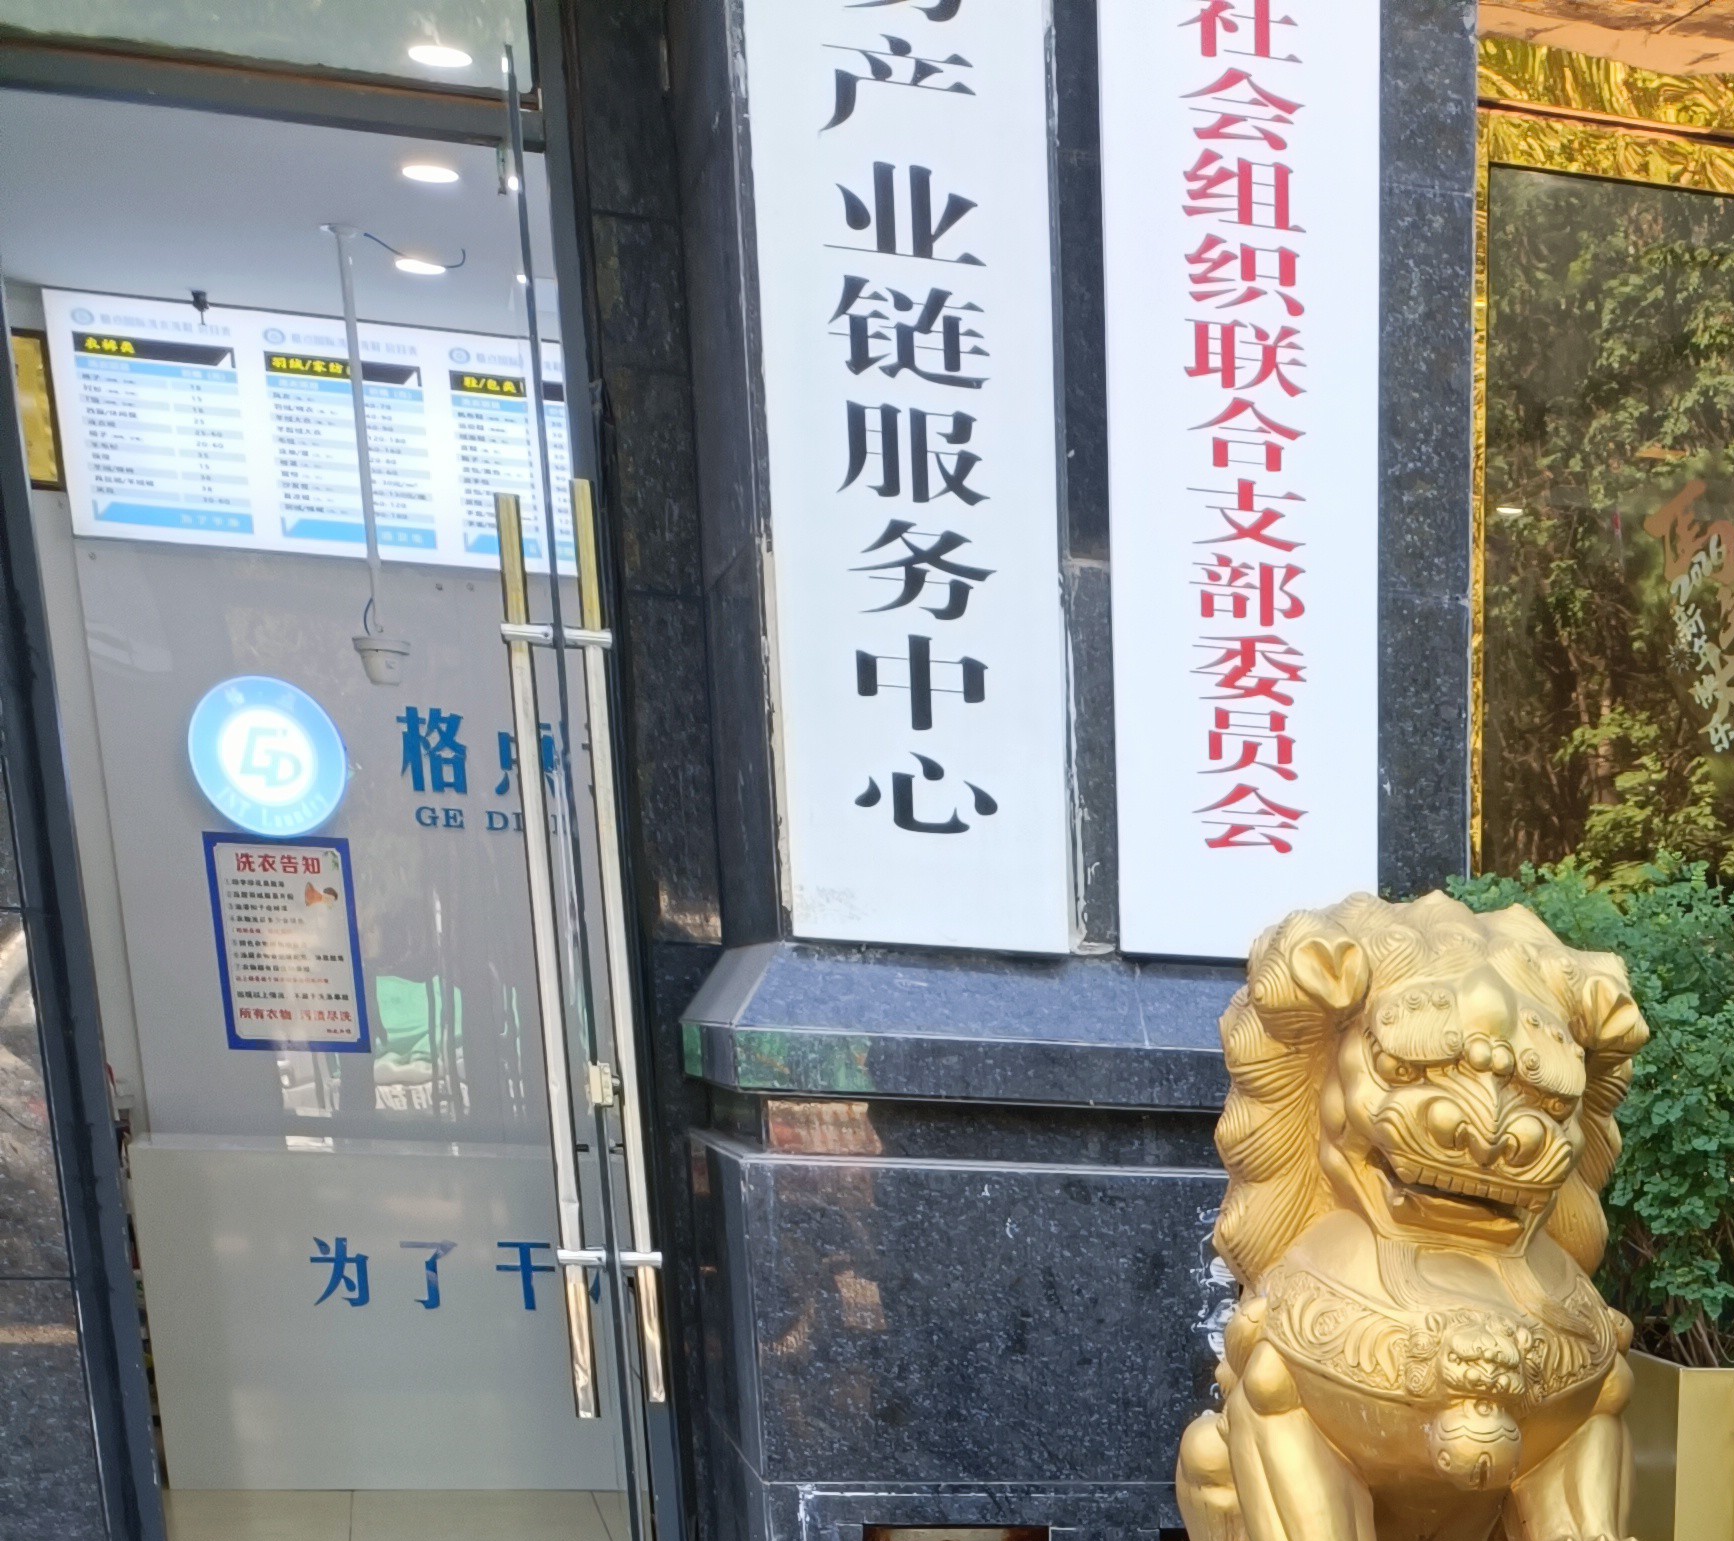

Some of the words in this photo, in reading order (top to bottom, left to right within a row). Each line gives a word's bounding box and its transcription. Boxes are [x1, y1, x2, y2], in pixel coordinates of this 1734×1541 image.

[271, 356, 350, 375] 羽绒/家纺
[819, 0, 998, 835] 产业链服务中心
[1176, 0, 1309, 854] 社会组织联合支部委员会
[414, 805, 466, 830] GE
[234, 851, 322, 875] 洗衣告知
[310, 1236, 602, 1311] 为了干
